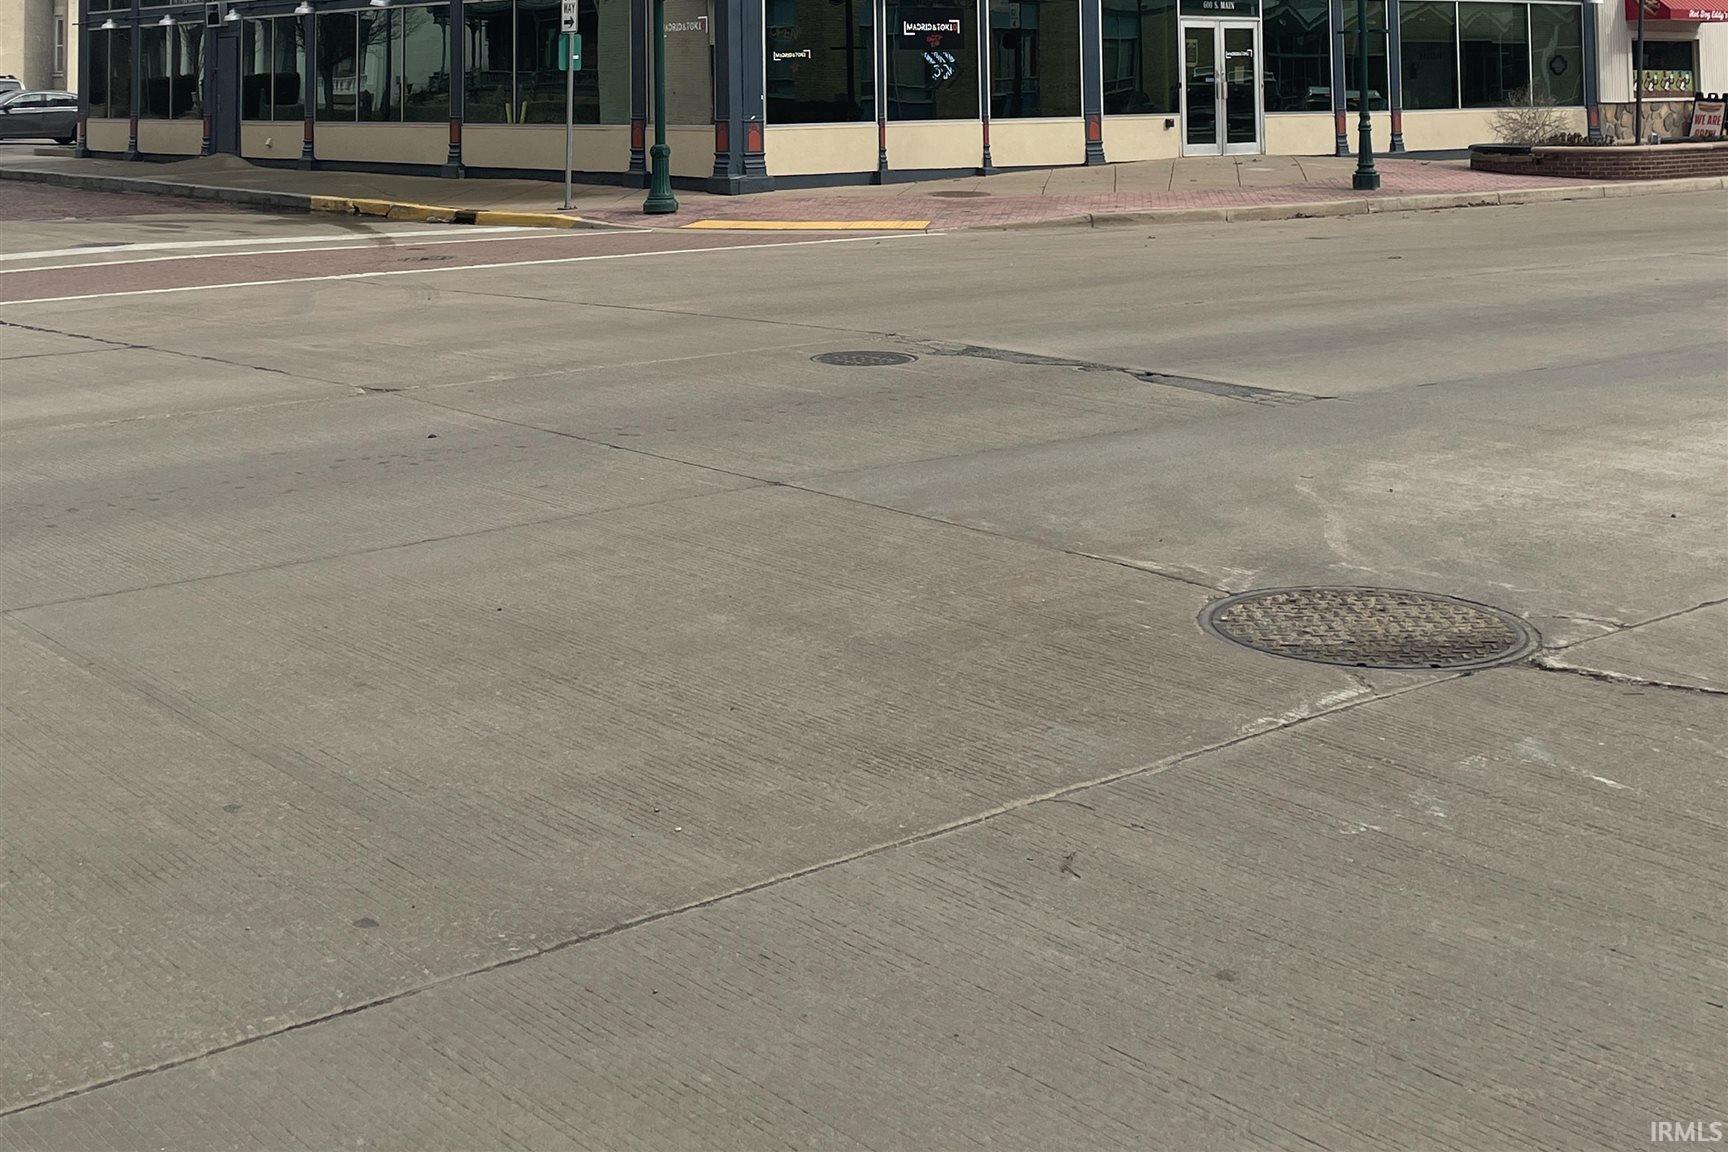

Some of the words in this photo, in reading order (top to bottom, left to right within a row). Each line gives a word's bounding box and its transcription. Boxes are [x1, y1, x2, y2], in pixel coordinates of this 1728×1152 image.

[564, 3, 575, 14] WAY
[1221, 1, 1235, 9] MAIN
[1688, 9, 1700, 18] Hot
[1700, 9, 1711, 20] Dog
[1695, 114, 1706, 125] WE
[1707, 115, 1721, 126] ARE
